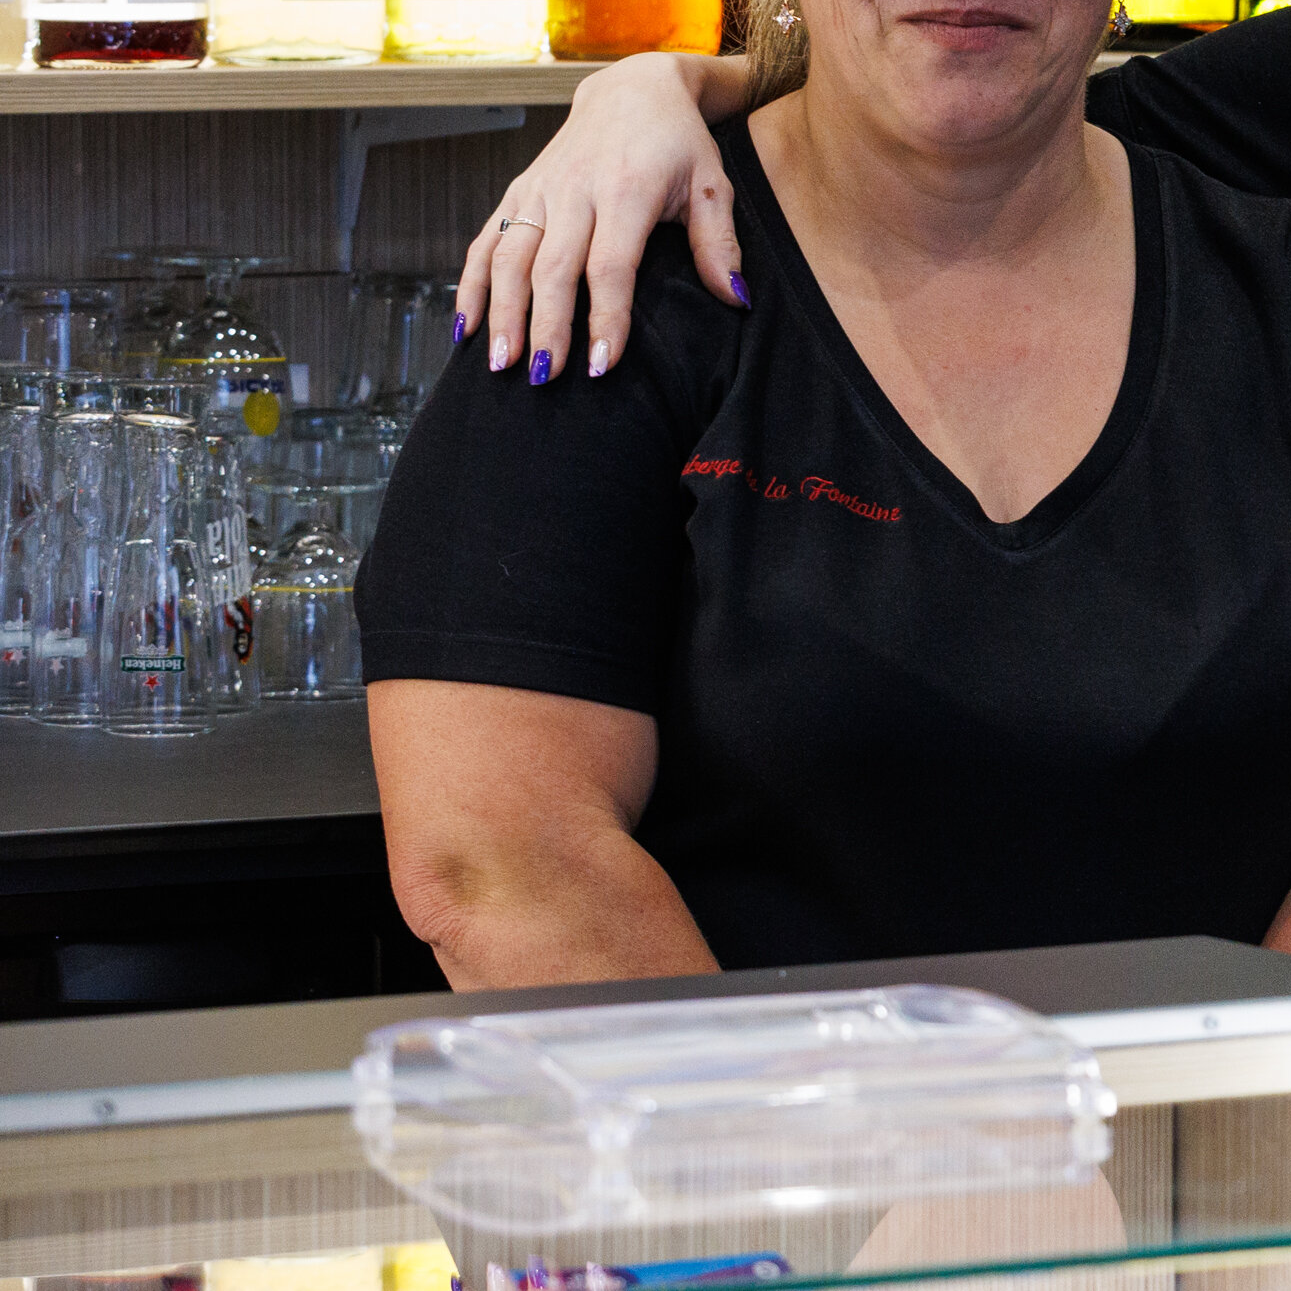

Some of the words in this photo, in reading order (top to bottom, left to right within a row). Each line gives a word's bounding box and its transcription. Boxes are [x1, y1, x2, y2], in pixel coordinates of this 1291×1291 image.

[764, 476, 791, 499] la
[800, 476, 902, 521] Fontaine
[125, 659, 182, 670] Heineken
